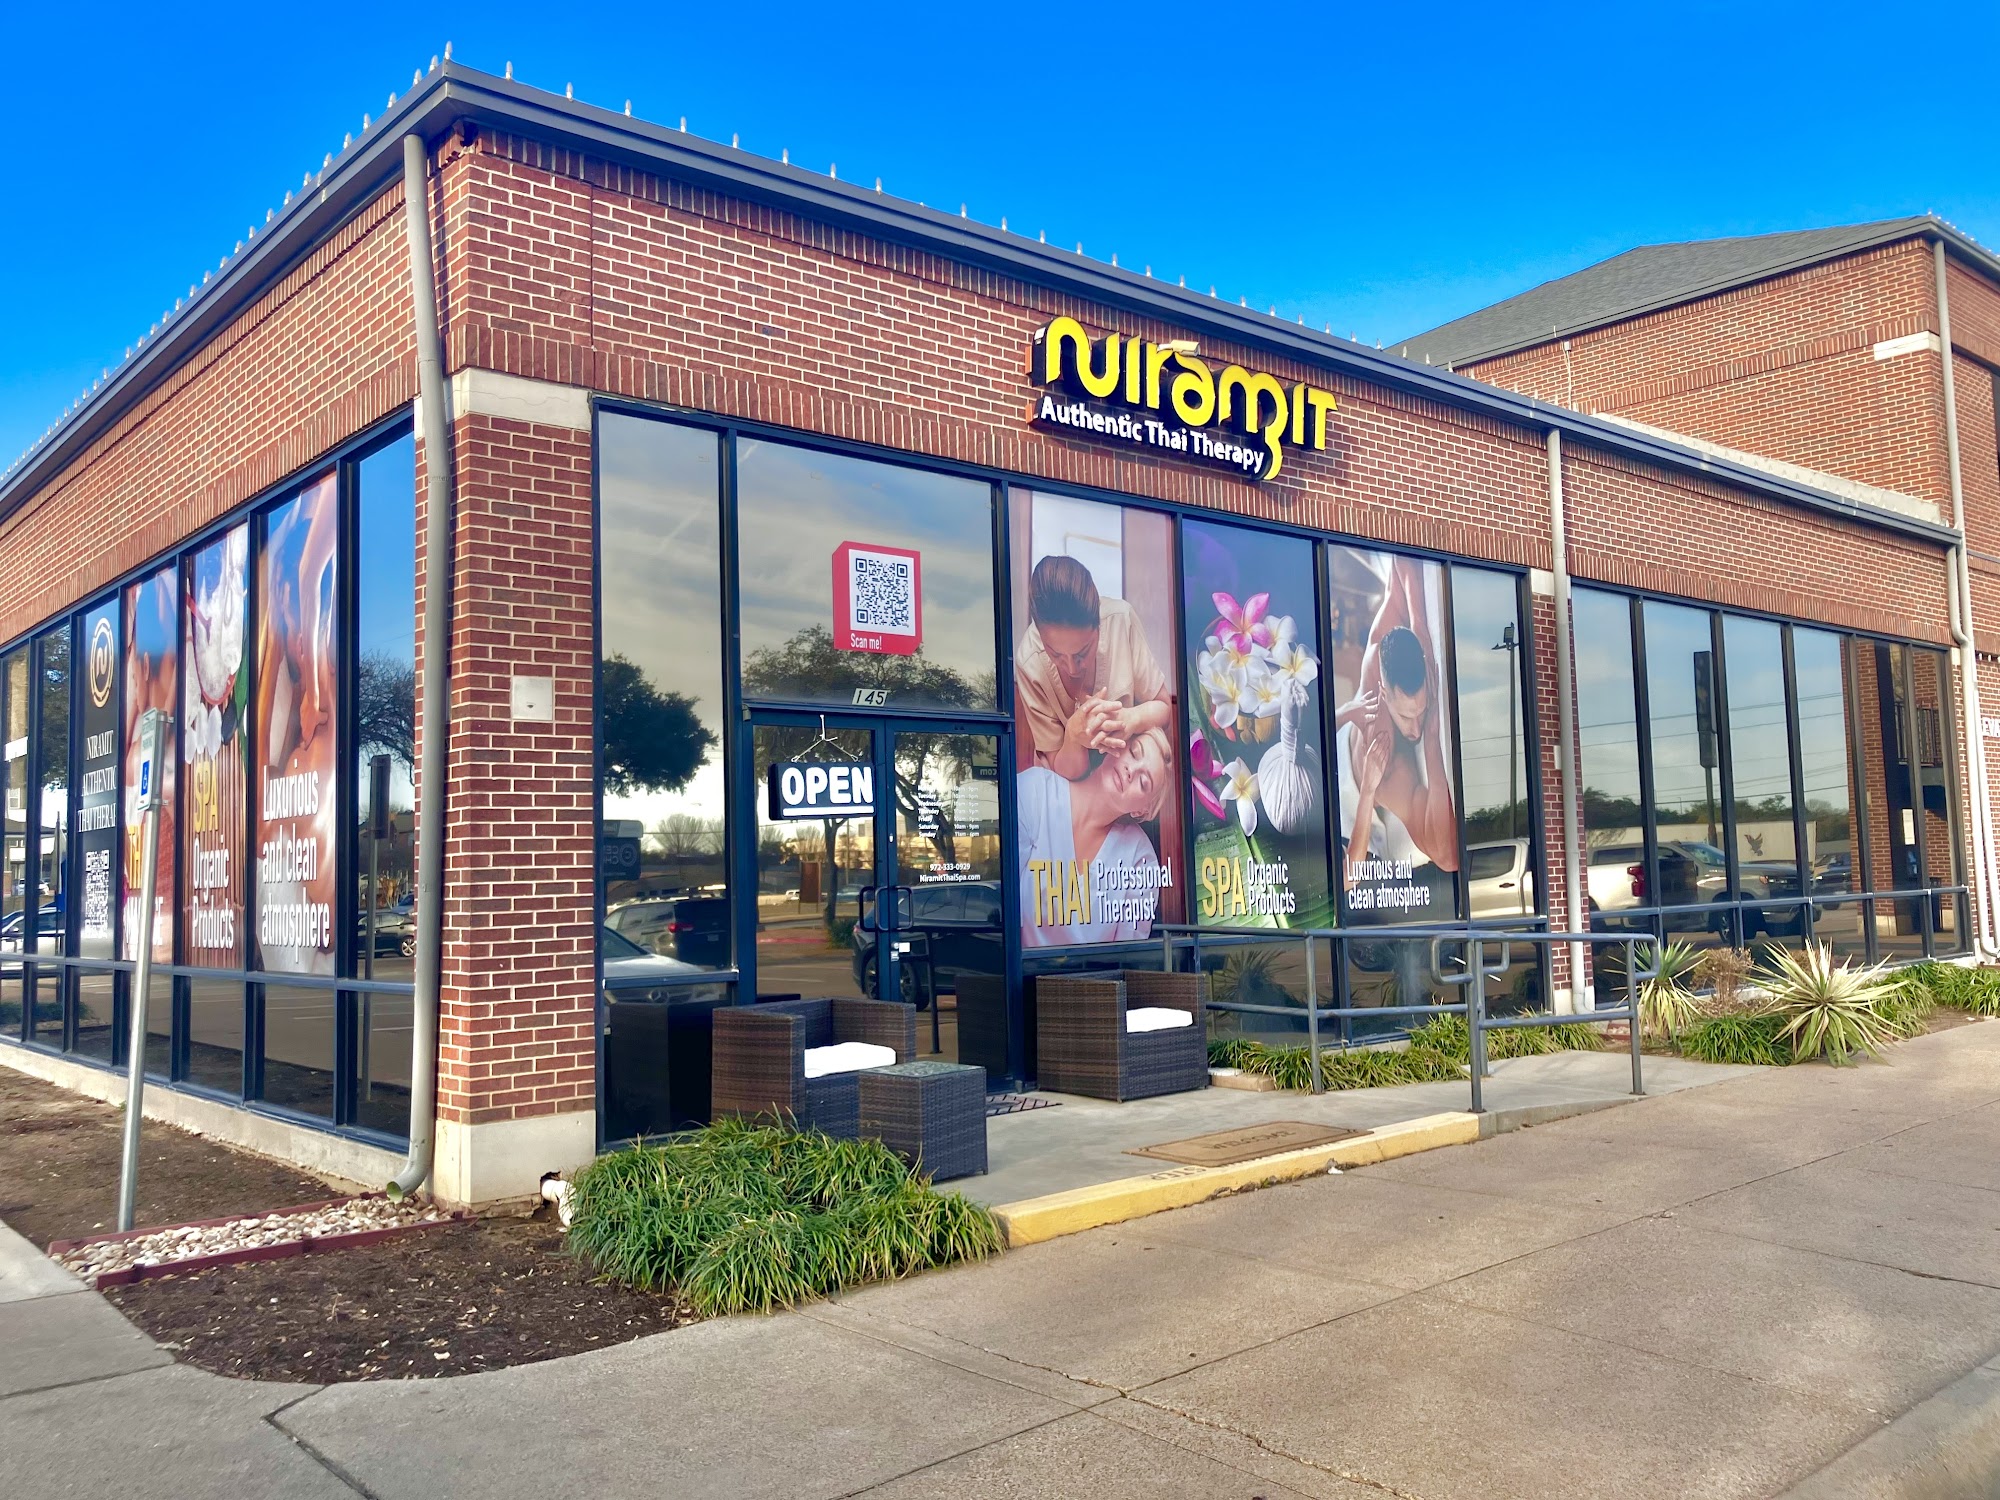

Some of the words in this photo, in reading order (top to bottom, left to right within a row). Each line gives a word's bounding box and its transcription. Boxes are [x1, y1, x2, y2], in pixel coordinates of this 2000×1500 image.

[1041, 396, 1143, 441] Authentic
[1144, 421, 1187, 450] Thai
[1190, 431, 1264, 473] Therapy
[850, 633, 868, 649] Scan
[869, 636, 882, 650] me!
[856, 689, 885, 705] 145
[194, 759, 219, 833] SPA
[263, 759, 319, 822] Luxurious
[781, 766, 874, 806] OPEN
[193, 835, 230, 903] Organic
[262, 825, 283, 883] and
[287, 823, 317, 882] clean
[1095, 856, 1174, 890] Professional
[1247, 855, 1289, 893] Organic
[1346, 853, 1393, 882] Luxurious
[1395, 852, 1413, 880] and
[1028, 859, 1092, 927] THAI
[1095, 890, 1156, 930] Therapist
[1201, 857, 1248, 918] SPA
[1248, 884, 1296, 915] Products
[1348, 880, 1375, 909] clean
[1376, 880, 1431, 914] atmosphere
[192, 895, 235, 949] Products
[261, 887, 330, 964] atmosphere
